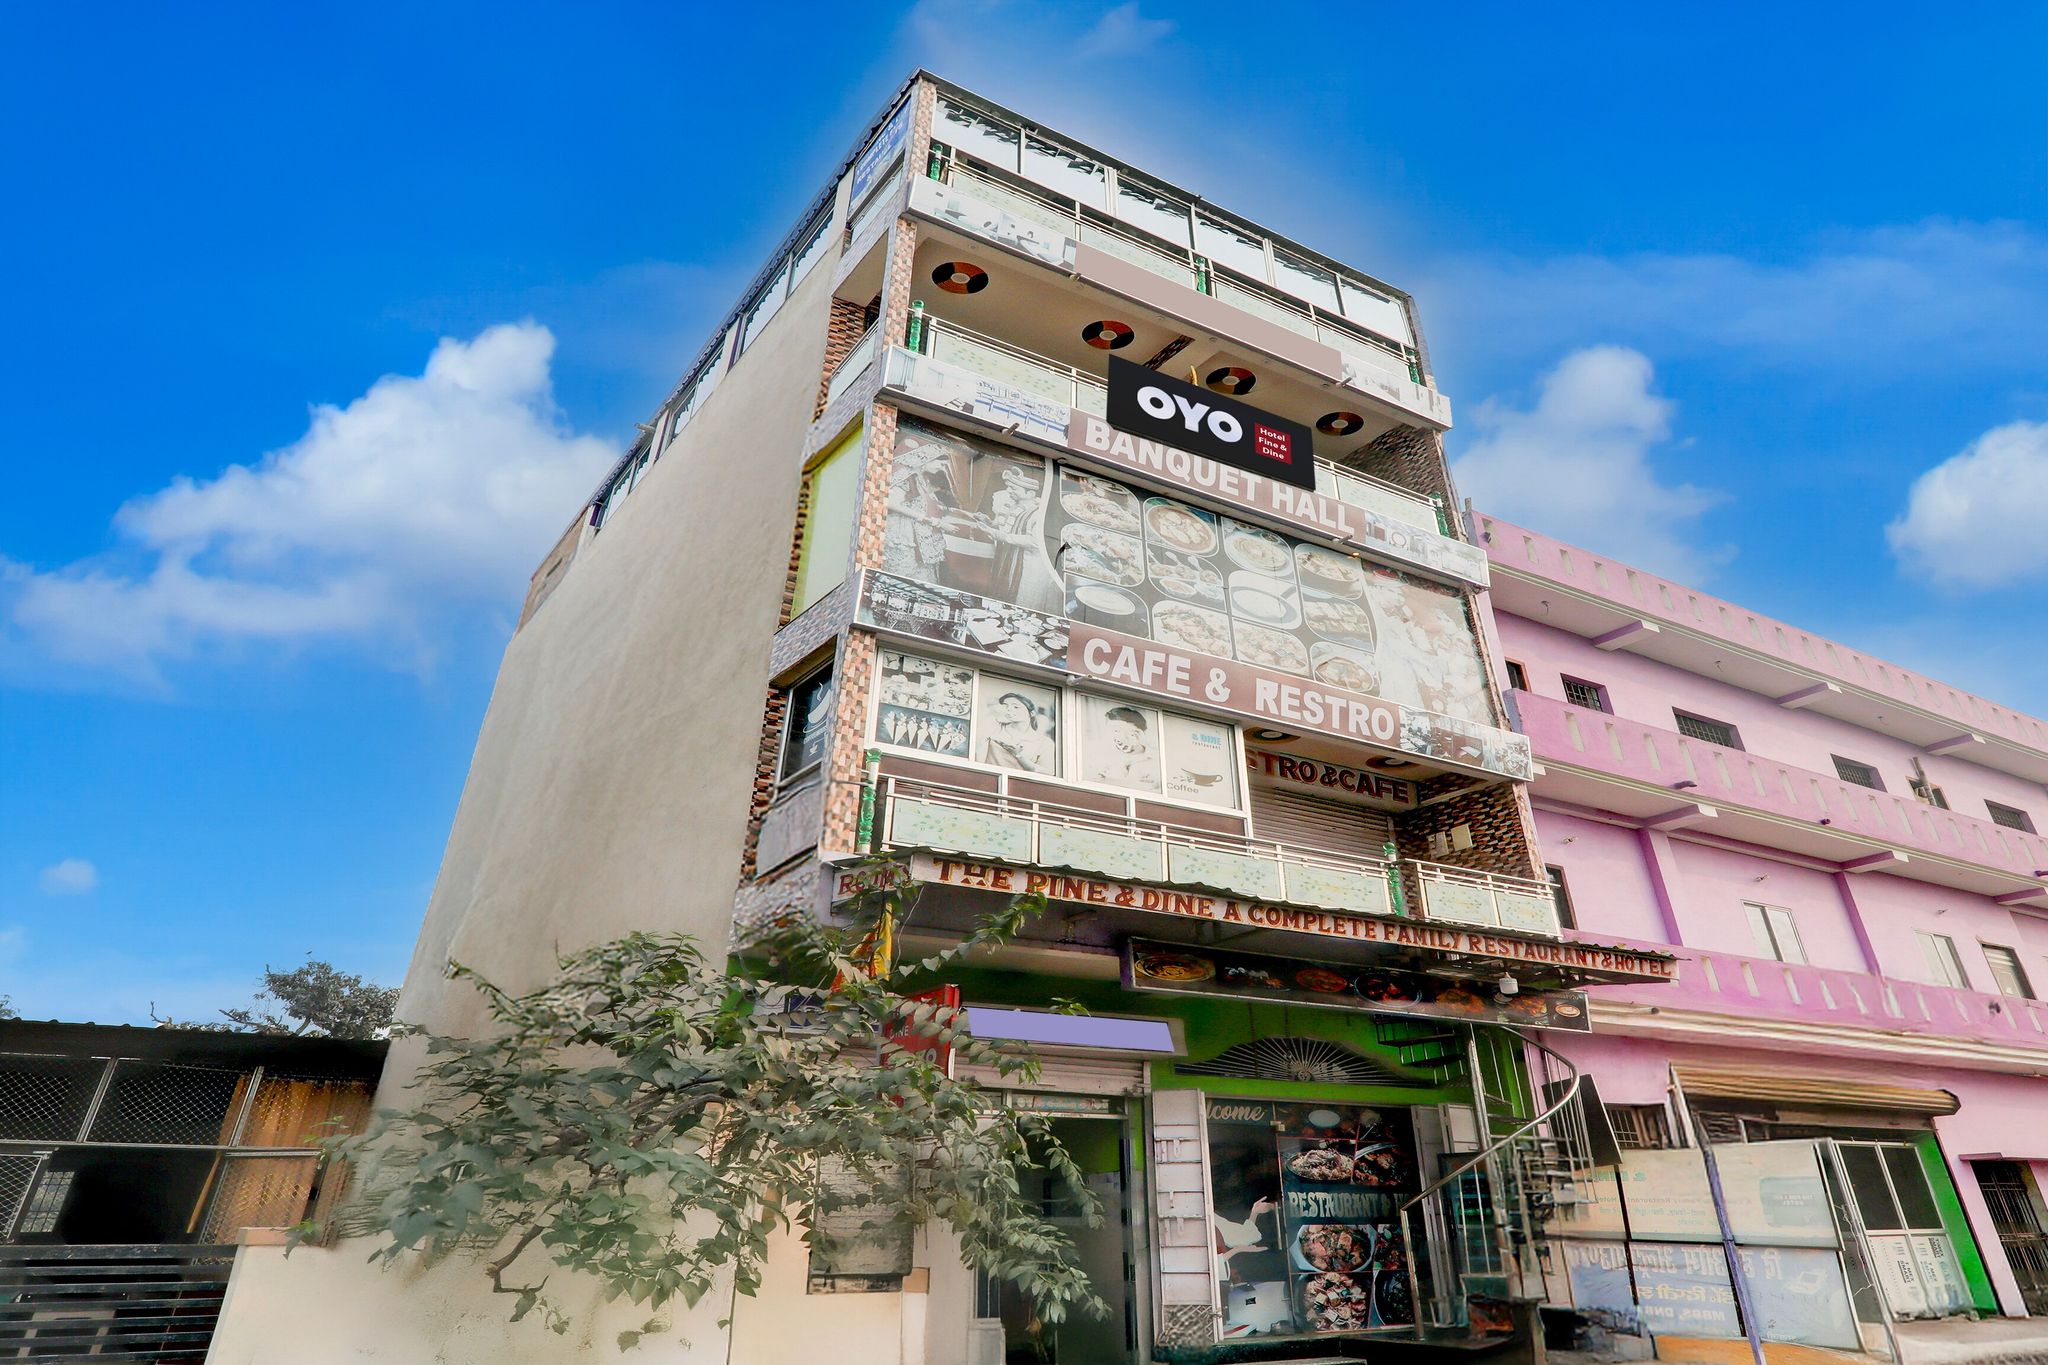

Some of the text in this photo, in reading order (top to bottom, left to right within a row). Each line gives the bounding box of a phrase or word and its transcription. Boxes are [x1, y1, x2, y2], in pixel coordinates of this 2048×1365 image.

[1136, 385, 1243, 443] OYO
[1258, 435, 1288, 452] Fine &
[1259, 427, 1286, 442] Hotel
[1262, 446, 1285, 460] Dine
[1085, 418, 1355, 532] BANQUET HALL
[1083, 638, 1395, 741] CAFE & RESTRO
[1167, 782, 1199, 794] Coffee
[933, 857, 1013, 891] THE
[1025, 870, 1108, 904] PINE
[1115, 882, 1138, 907] &
[1142, 887, 1216, 920] DINE
[1223, 902, 1242, 921] A
[1247, 905, 1377, 940] COMPLETE
[1382, 922, 1464, 951] FAMILY
[1206, 1101, 1265, 1121] lcome
